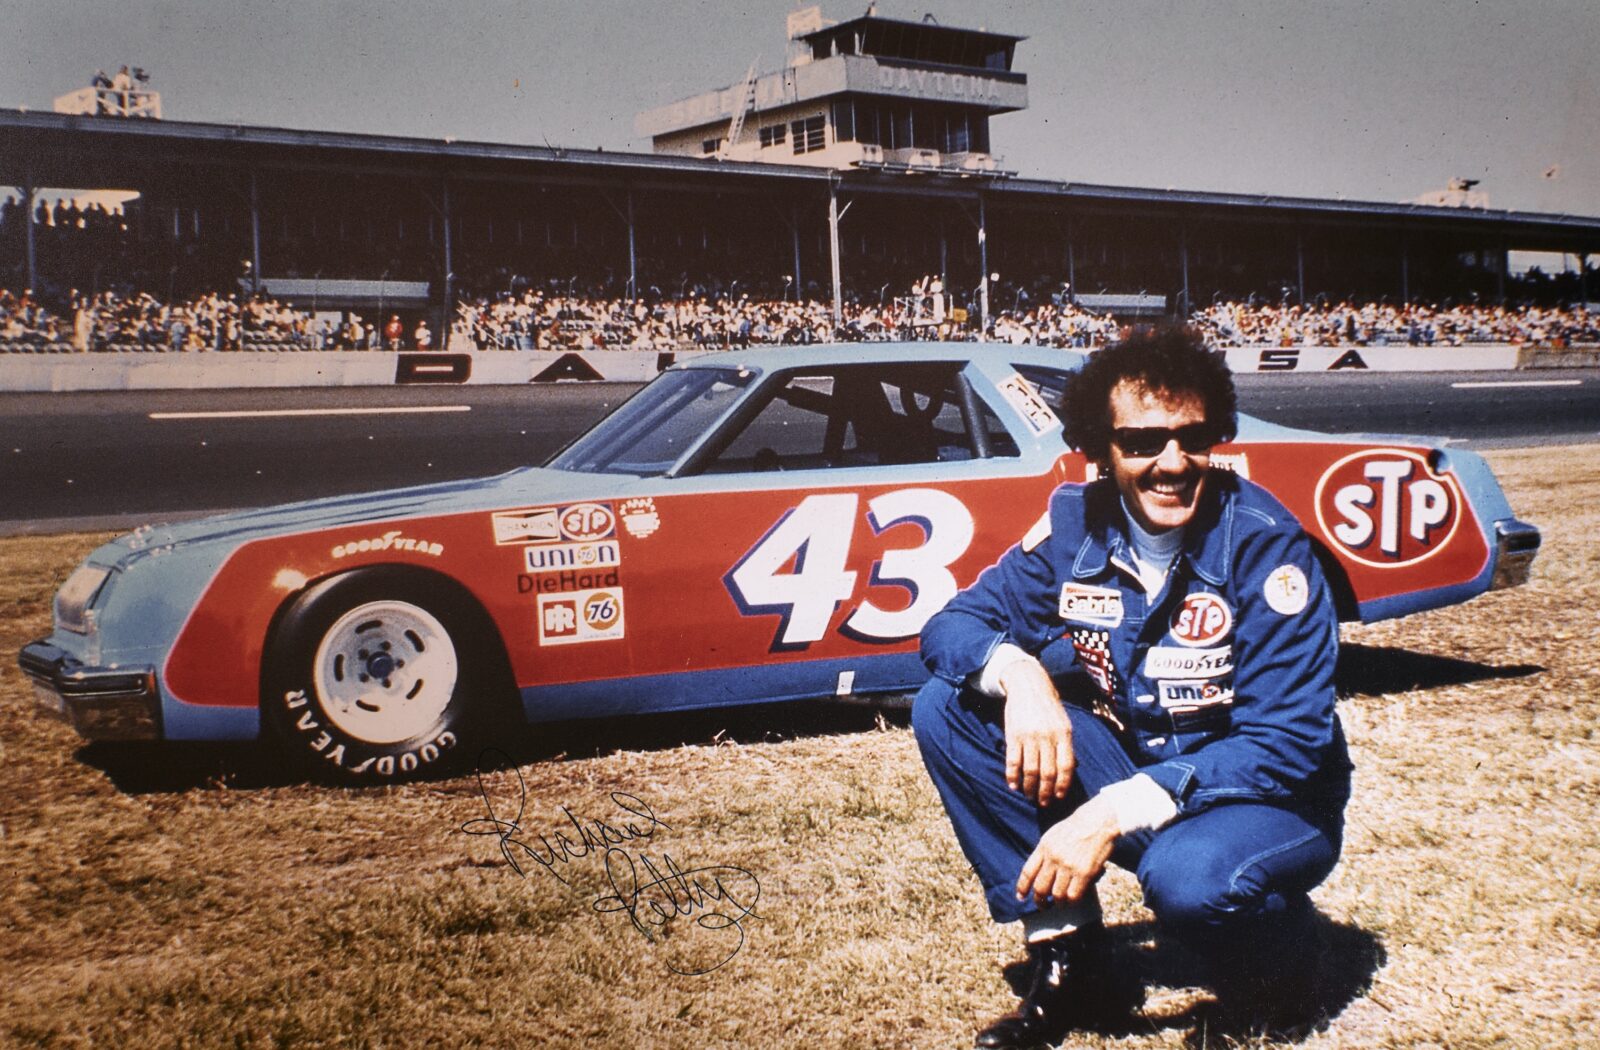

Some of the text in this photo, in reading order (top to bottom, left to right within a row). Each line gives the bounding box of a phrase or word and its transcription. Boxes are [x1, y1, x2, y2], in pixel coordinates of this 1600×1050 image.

[567, 507, 607, 533] STP
[1334, 460, 1451, 556] STP
[332, 531, 444, 556] GOODYEAR
[517, 571, 619, 593] DieHard
[722, 488, 974, 653] 43
[590, 600, 613, 620] 76
[1175, 599, 1225, 637] STP
[1153, 655, 1233, 672] GOODYEA
[284, 689, 457, 775] GOODYEAR
